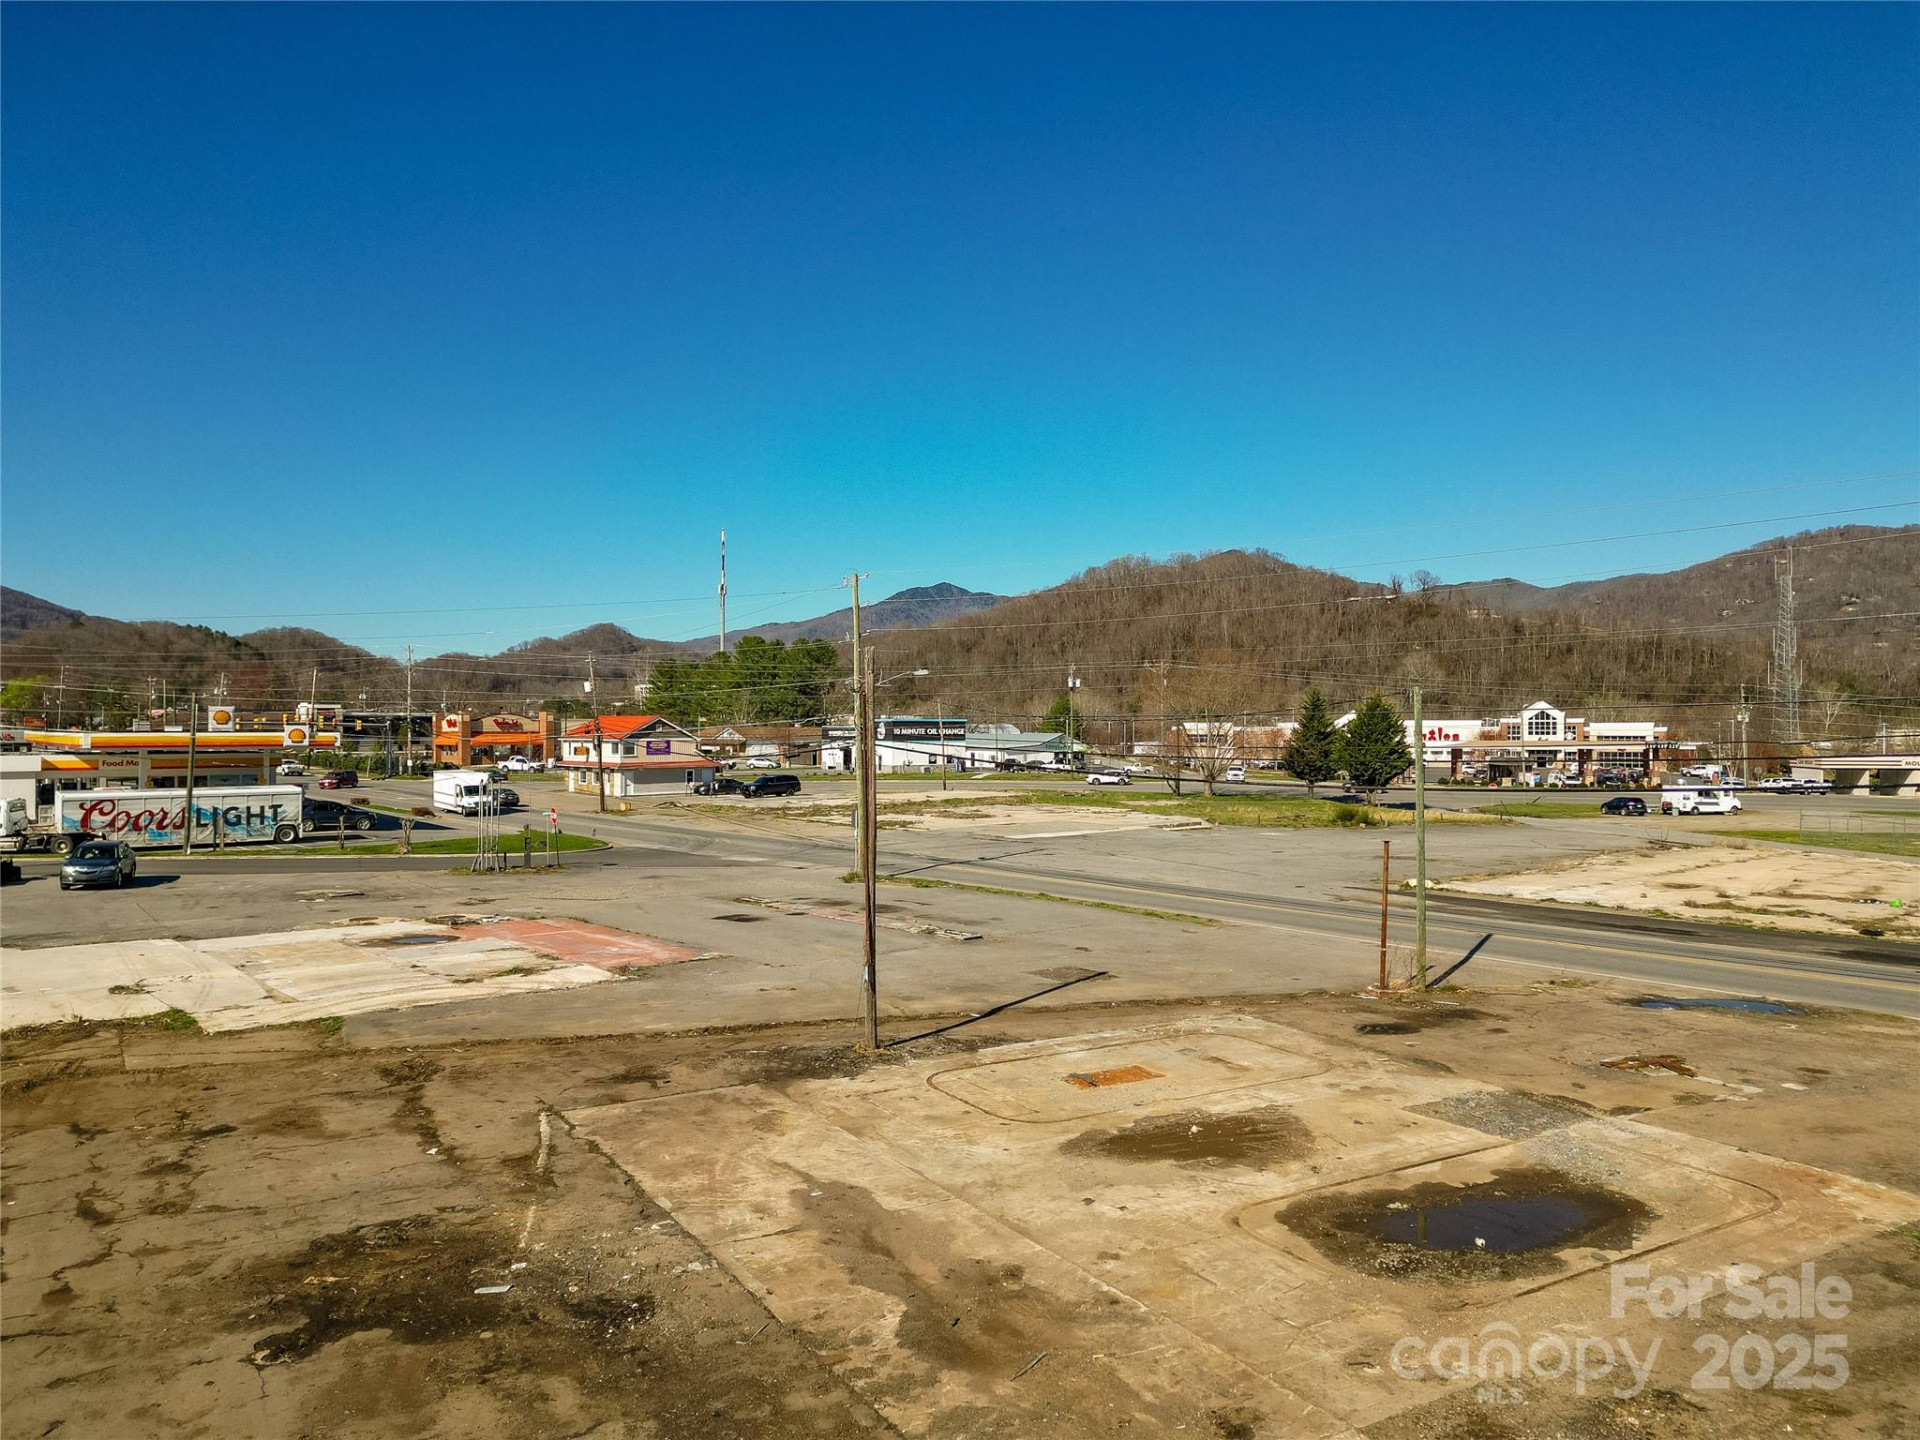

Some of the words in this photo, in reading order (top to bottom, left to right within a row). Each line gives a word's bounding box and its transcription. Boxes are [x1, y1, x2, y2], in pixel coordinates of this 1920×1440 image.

[102, 759, 123, 767] Food
[79, 799, 186, 833] Coors
[196, 804, 283, 828] LIGHT
